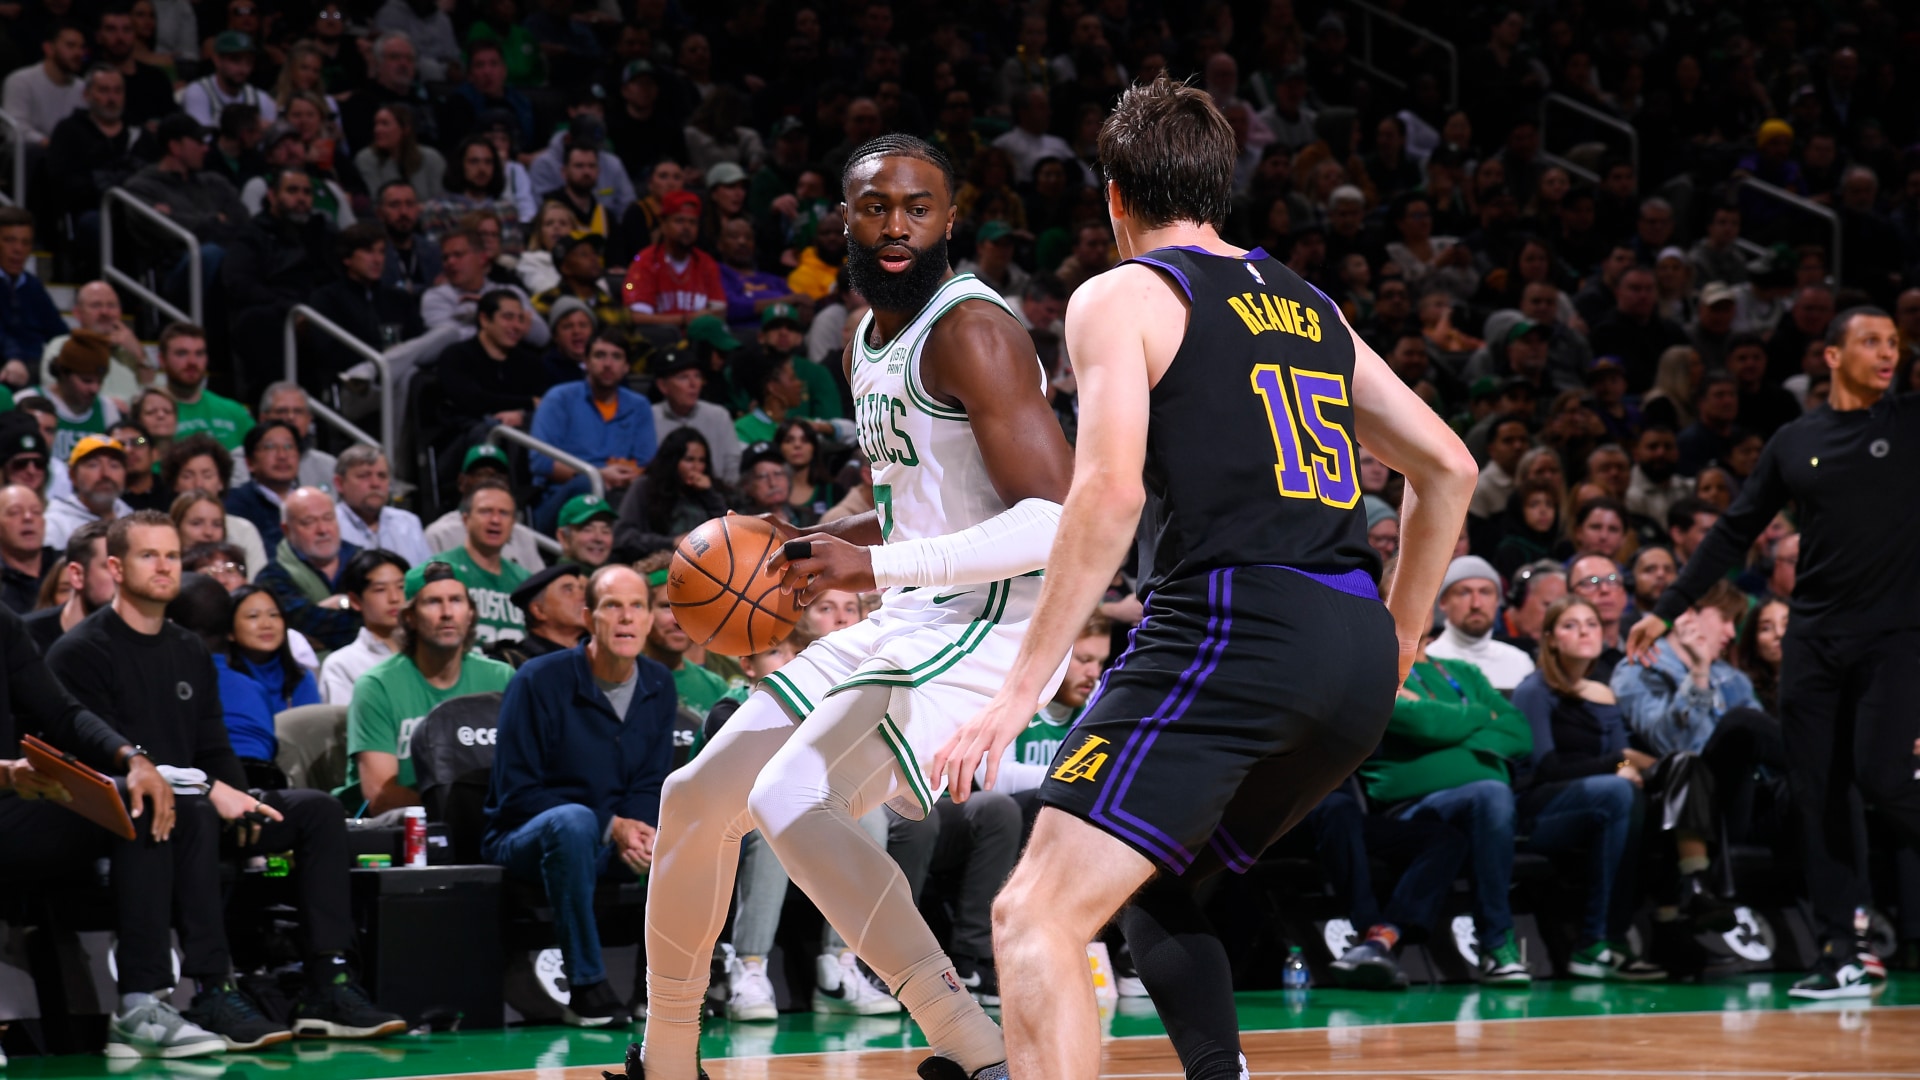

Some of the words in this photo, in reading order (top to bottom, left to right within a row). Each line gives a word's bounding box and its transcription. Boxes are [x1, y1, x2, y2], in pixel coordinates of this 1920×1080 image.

[1227, 292, 1321, 342] REAVES
[887, 363, 903, 375] PRINT
[889, 347, 907, 362] VISTA
[1250, 363, 1361, 509] 15
[873, 484, 894, 545] 7
